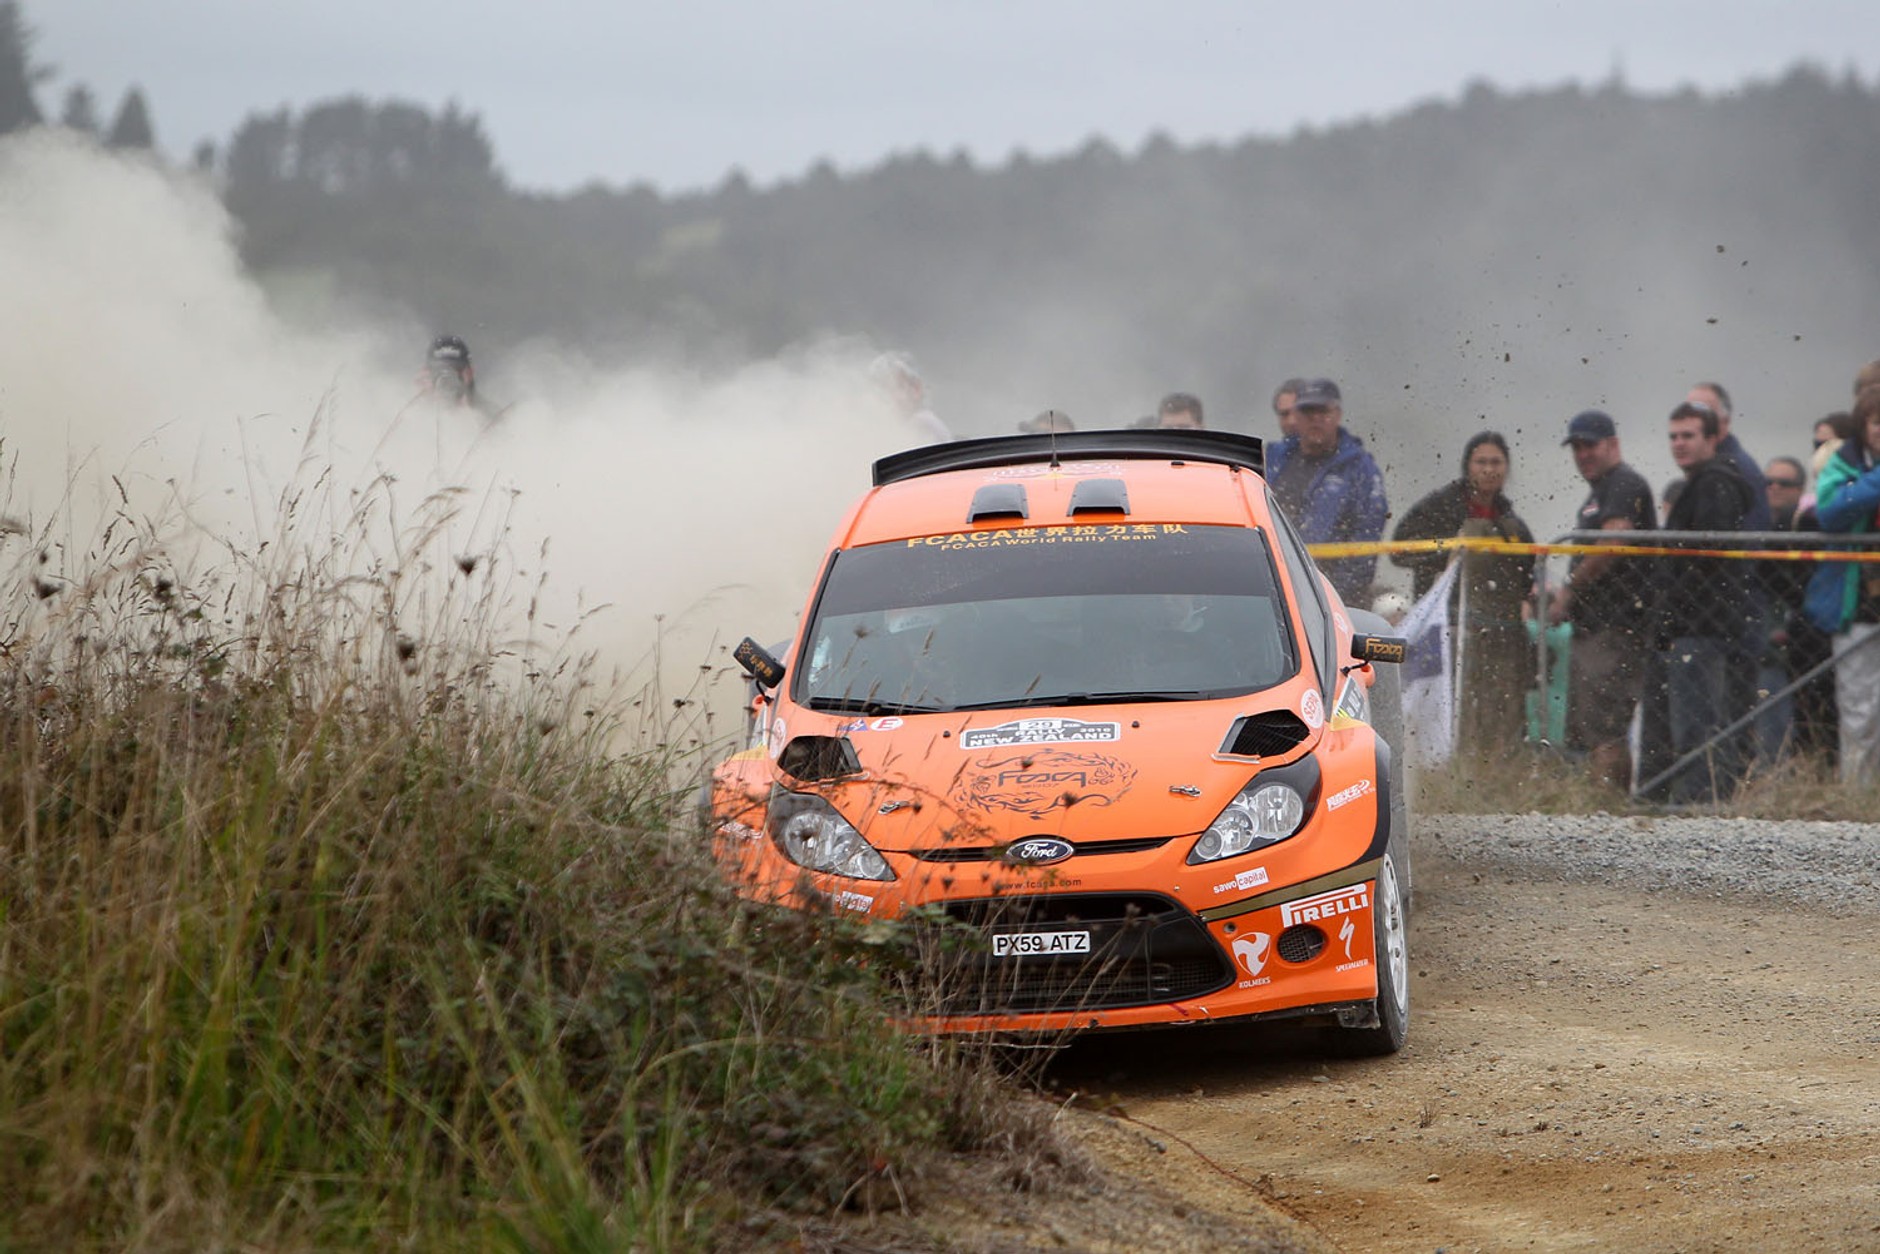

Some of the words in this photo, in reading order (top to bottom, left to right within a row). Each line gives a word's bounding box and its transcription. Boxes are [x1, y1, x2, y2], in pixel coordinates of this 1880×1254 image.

[941, 540, 1001, 551] FCACA
[1005, 536, 1056, 546] World
[1062, 535, 1107, 543] Rally
[970, 736, 1014, 747] NEW
[1019, 732, 1113, 743] ZEALAND
[1015, 728, 1066, 737] RALLY
[1021, 843, 1059, 858] Ford
[1238, 871, 1266, 887] capital
[1280, 883, 1369, 928] PIRELLI
[996, 935, 1043, 953] PX59
[1050, 934, 1087, 951] ATZ
